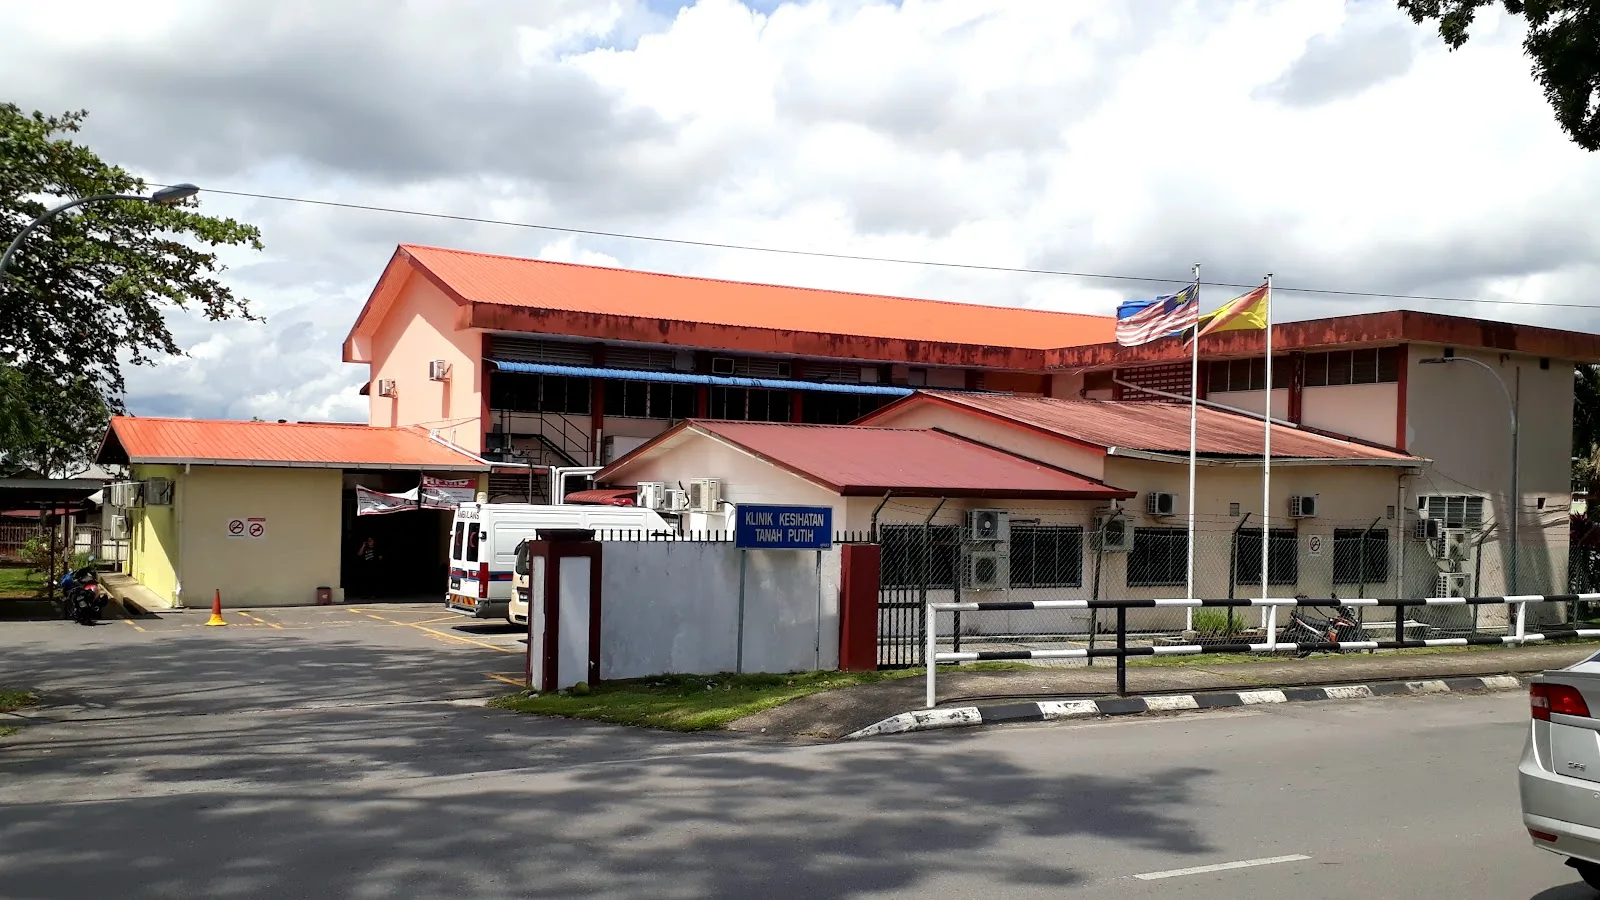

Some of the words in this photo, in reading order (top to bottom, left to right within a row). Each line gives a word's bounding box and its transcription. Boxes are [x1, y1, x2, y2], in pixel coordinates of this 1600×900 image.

[745, 512, 773, 525] KLINIK
[779, 513, 824, 526] KESIHATAN
[755, 529, 782, 542] TANAH
[788, 530, 814, 542] PUTIH
